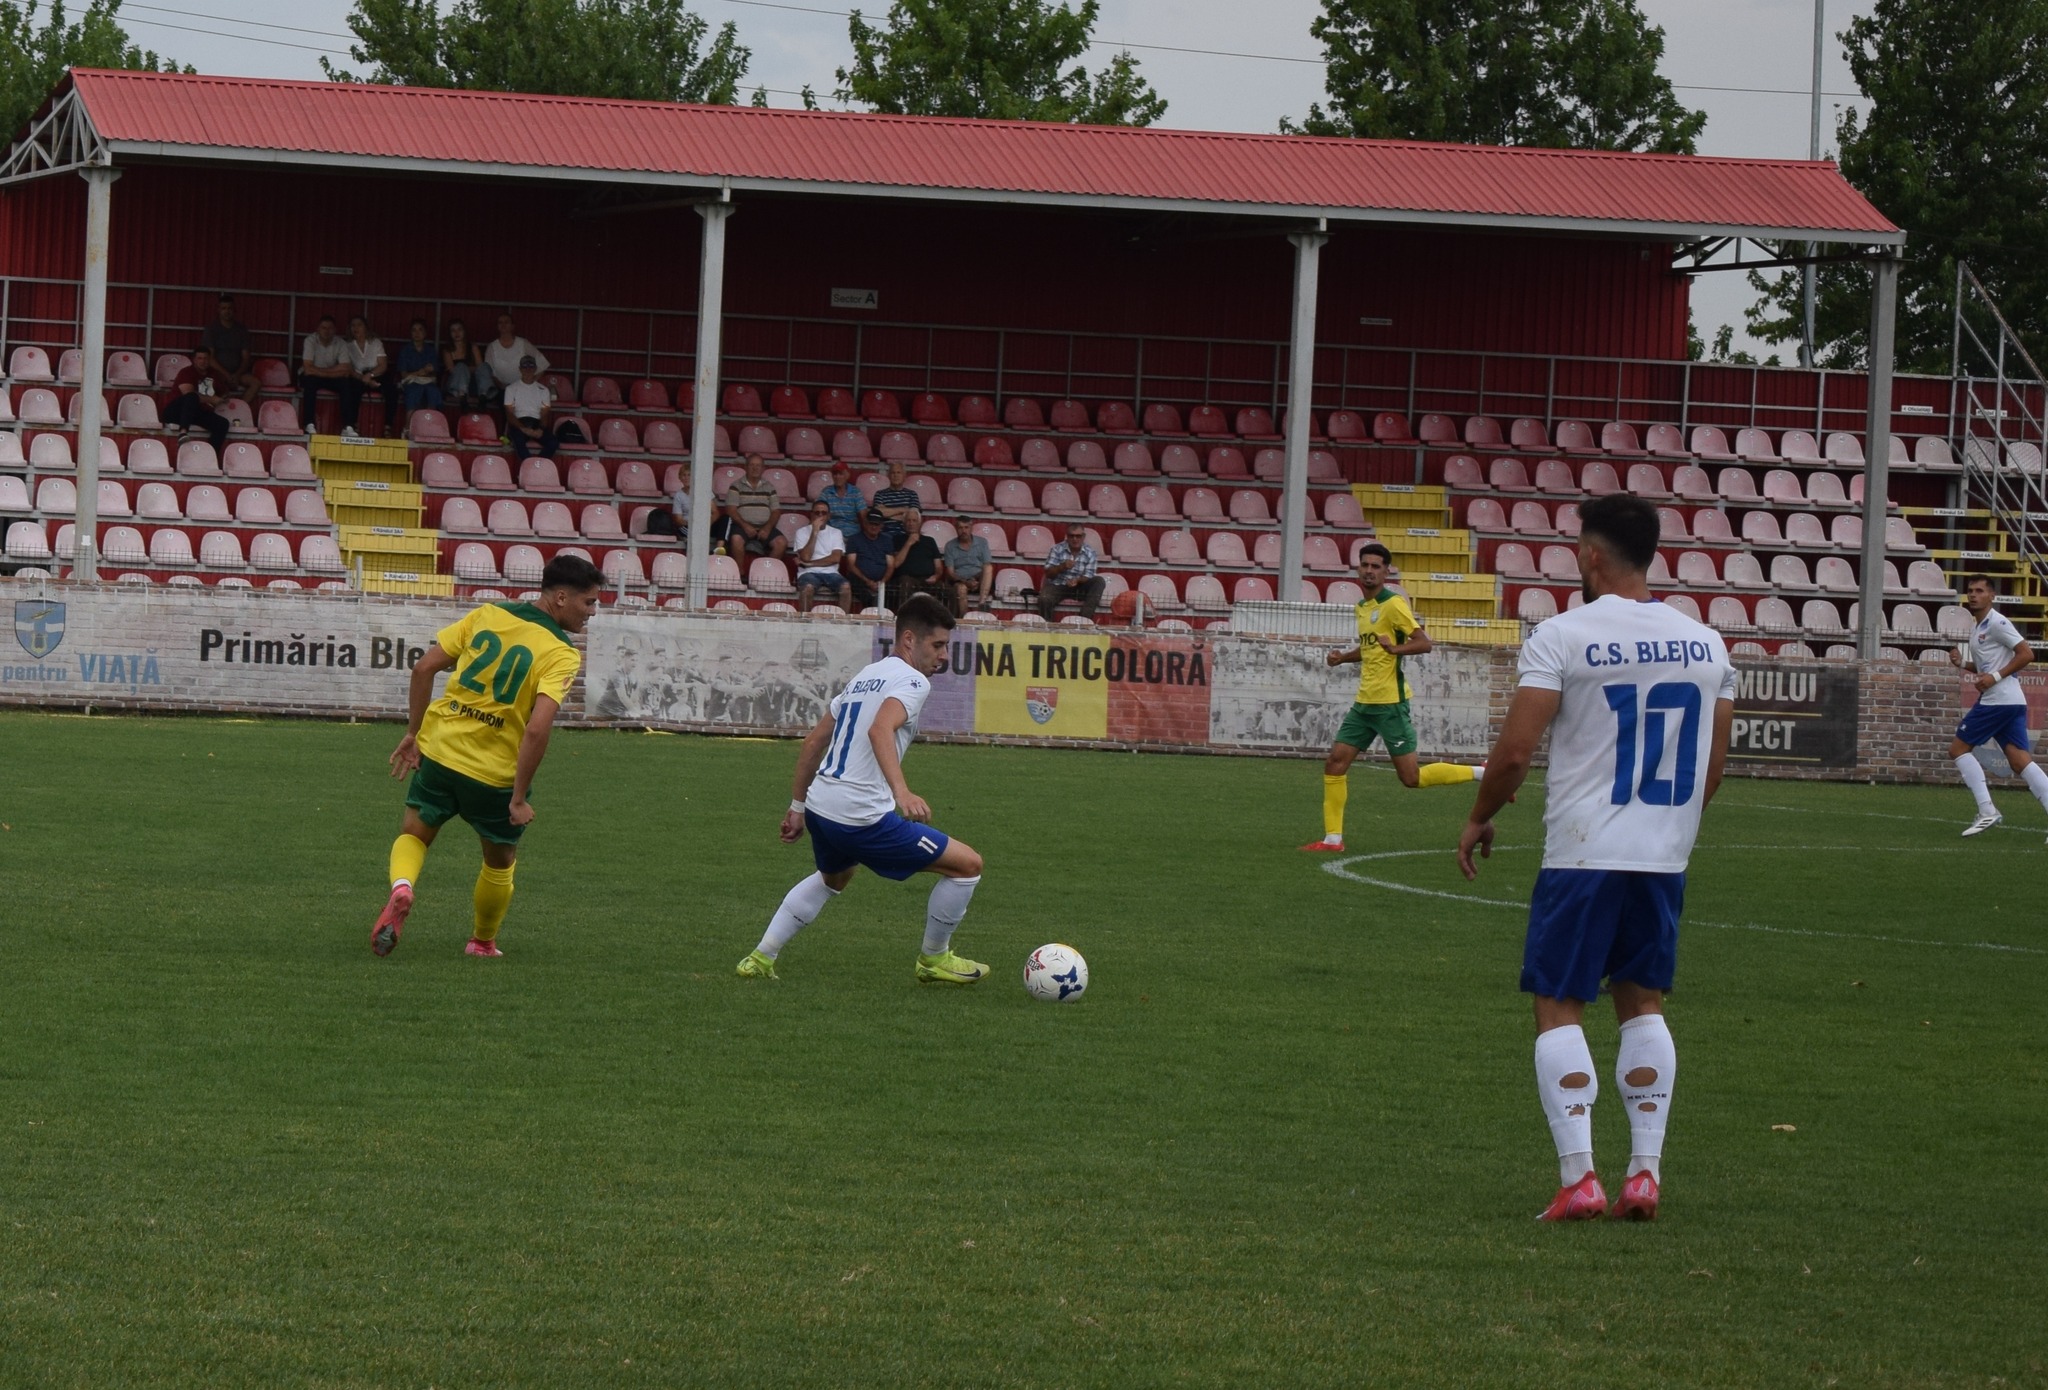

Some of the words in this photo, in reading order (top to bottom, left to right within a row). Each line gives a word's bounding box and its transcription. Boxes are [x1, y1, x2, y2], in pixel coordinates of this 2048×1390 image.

[833, 292, 862, 304] Sector
[865, 291, 876, 304] A
[200, 629, 357, 668] Primăria
[459, 629, 534, 705] 20
[1028, 643, 1207, 686] TRICOLORĂ
[1585, 642, 1629, 667] C.S.
[1635, 639, 1713, 669] BLEJOI
[2, 663, 67, 683] pentru
[79, 648, 161, 696] VIAȚĂ
[819, 701, 863, 779] 11
[1602, 682, 1702, 806] 10
[917, 835, 938, 855] 11
